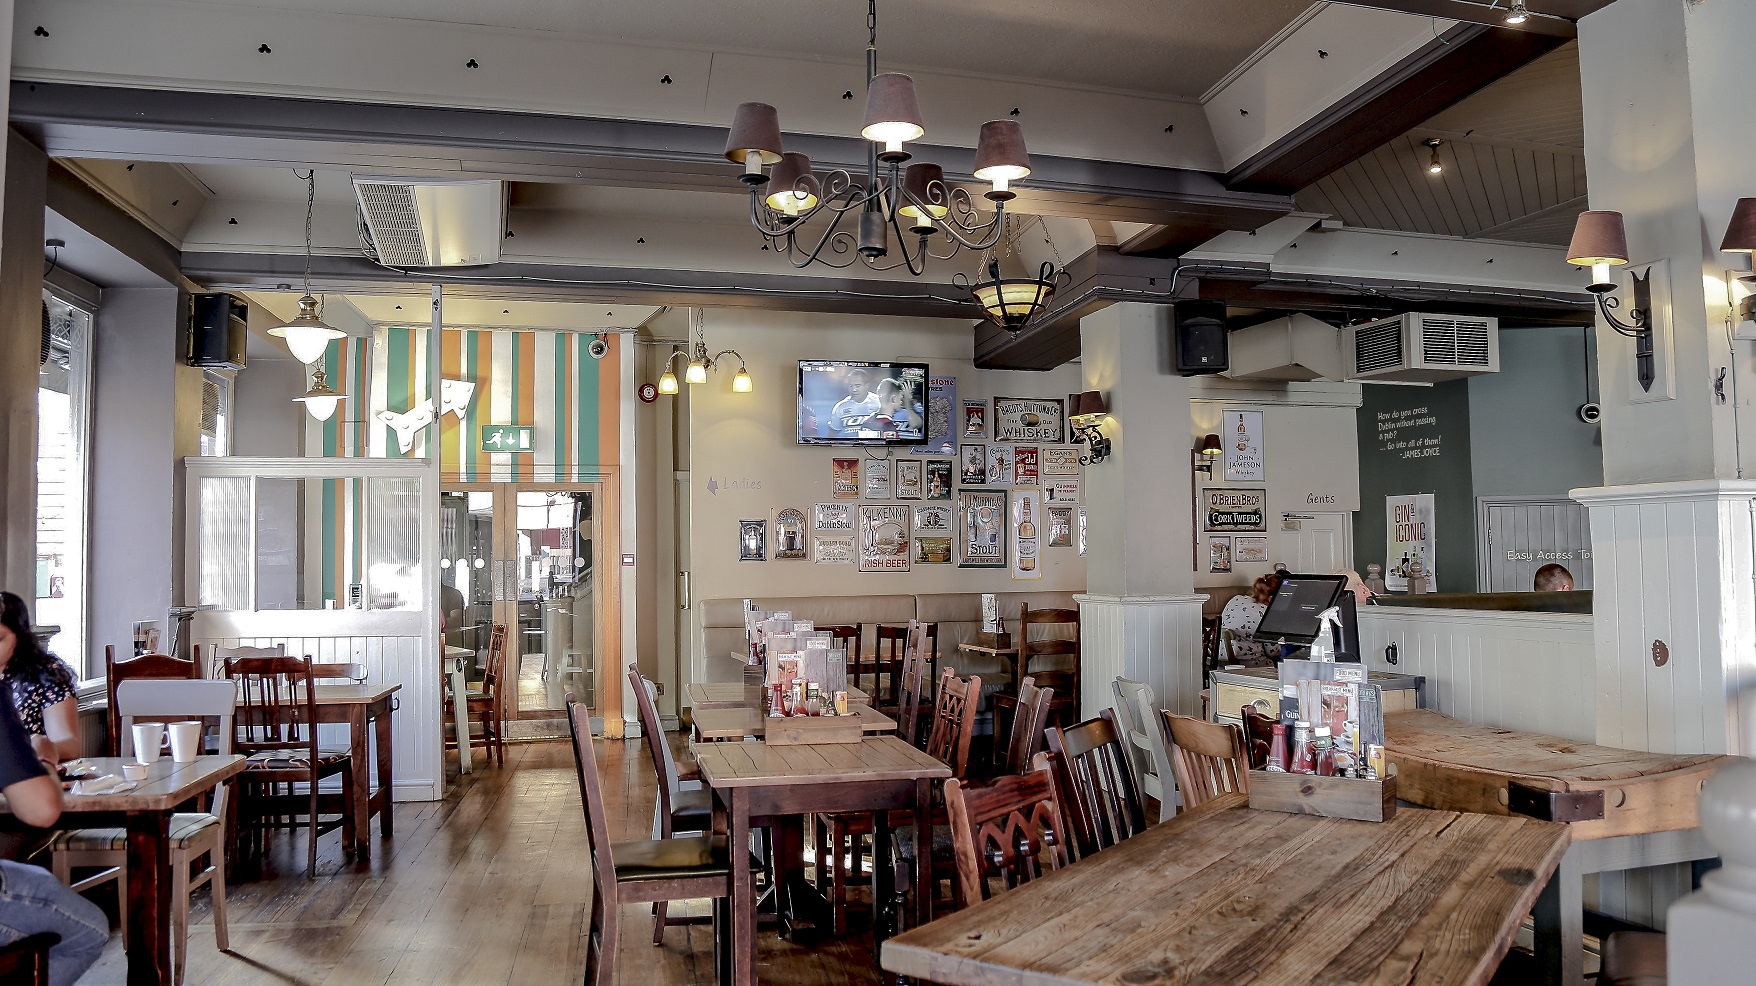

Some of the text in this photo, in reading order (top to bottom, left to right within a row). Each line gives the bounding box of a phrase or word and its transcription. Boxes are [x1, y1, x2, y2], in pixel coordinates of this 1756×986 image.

[1392, 410, 1399, 418] do
[1401, 410, 1411, 419] you
[1379, 416, 1436, 431] Dublin without passing
[1003, 427, 1057, 438] WHISKEY
[1384, 431, 1397, 441] pub?
[1387, 442, 1394, 450] Go
[1425, 435, 1441, 445] them!
[1421, 447, 1440, 456] JOYCE
[1234, 469, 1255, 477] Whiskey
[724, 476, 761, 489] Ladies
[1211, 493, 1241, 506] O'BRIEN
[1306, 492, 1335, 504] Gents
[862, 507, 907, 522] KILKENNY
[1212, 512, 1260, 524] CORK TWEEDS
[1395, 504, 1410, 523] GIN
[1395, 522, 1426, 542] ICONIC
[970, 544, 998, 555] STOUT
[1507, 550, 1533, 563] Easy
[1537, 550, 1573, 560] Access
[862, 559, 907, 568] IRISH BEER
